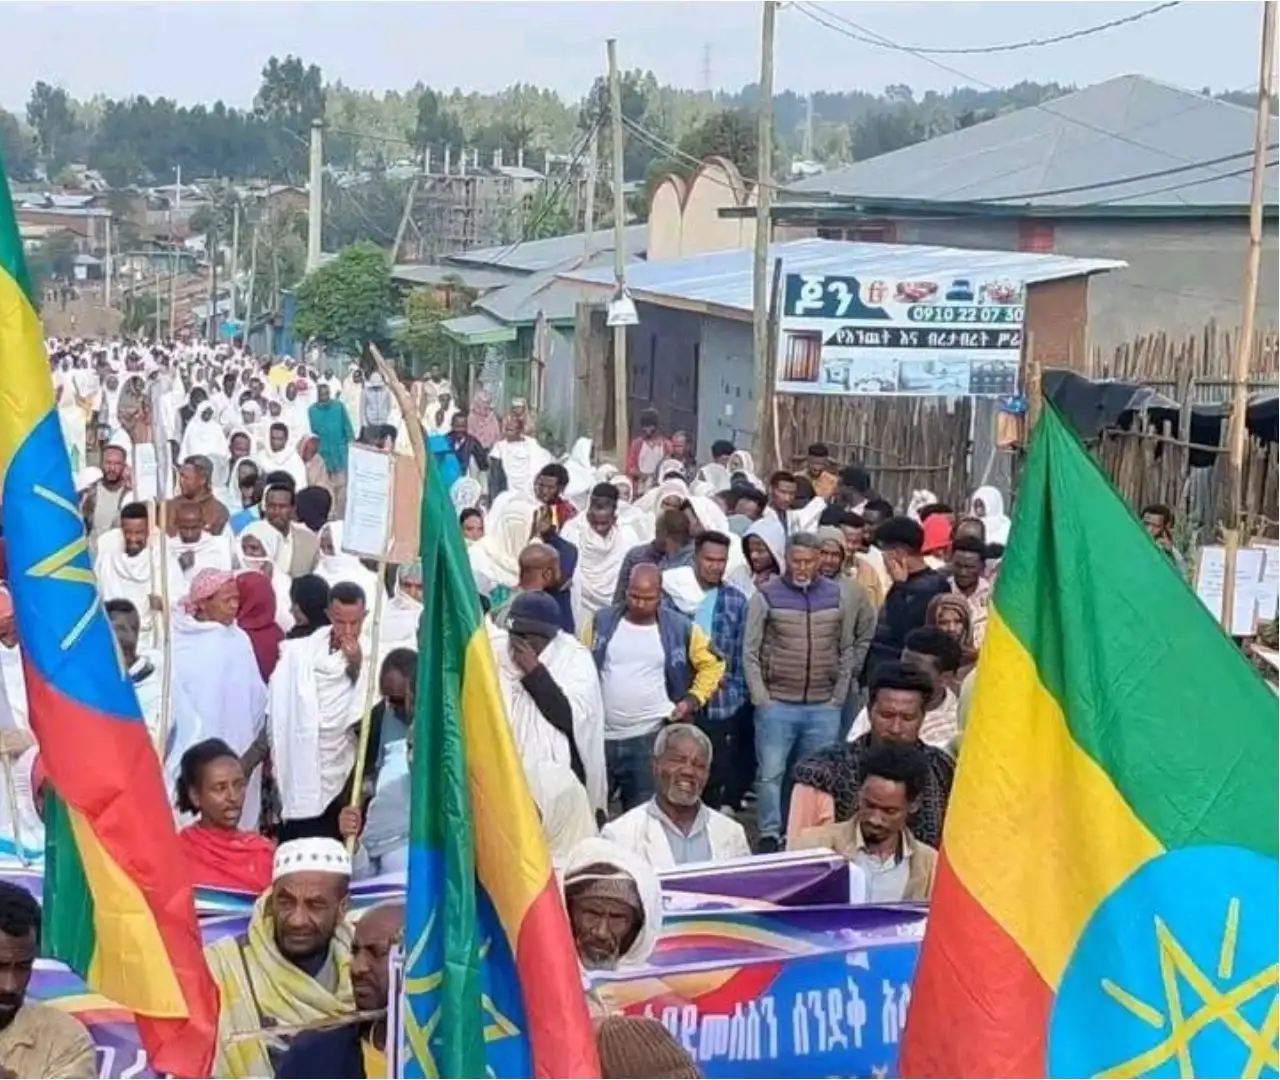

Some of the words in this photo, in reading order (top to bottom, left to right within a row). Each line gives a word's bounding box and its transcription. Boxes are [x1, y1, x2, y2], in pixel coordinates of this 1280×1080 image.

[795, 274, 853, 316] ጆን
[913, 307, 953, 322] 0910
[957, 307, 977, 322] 22
[980, 307, 1000, 322] 07
